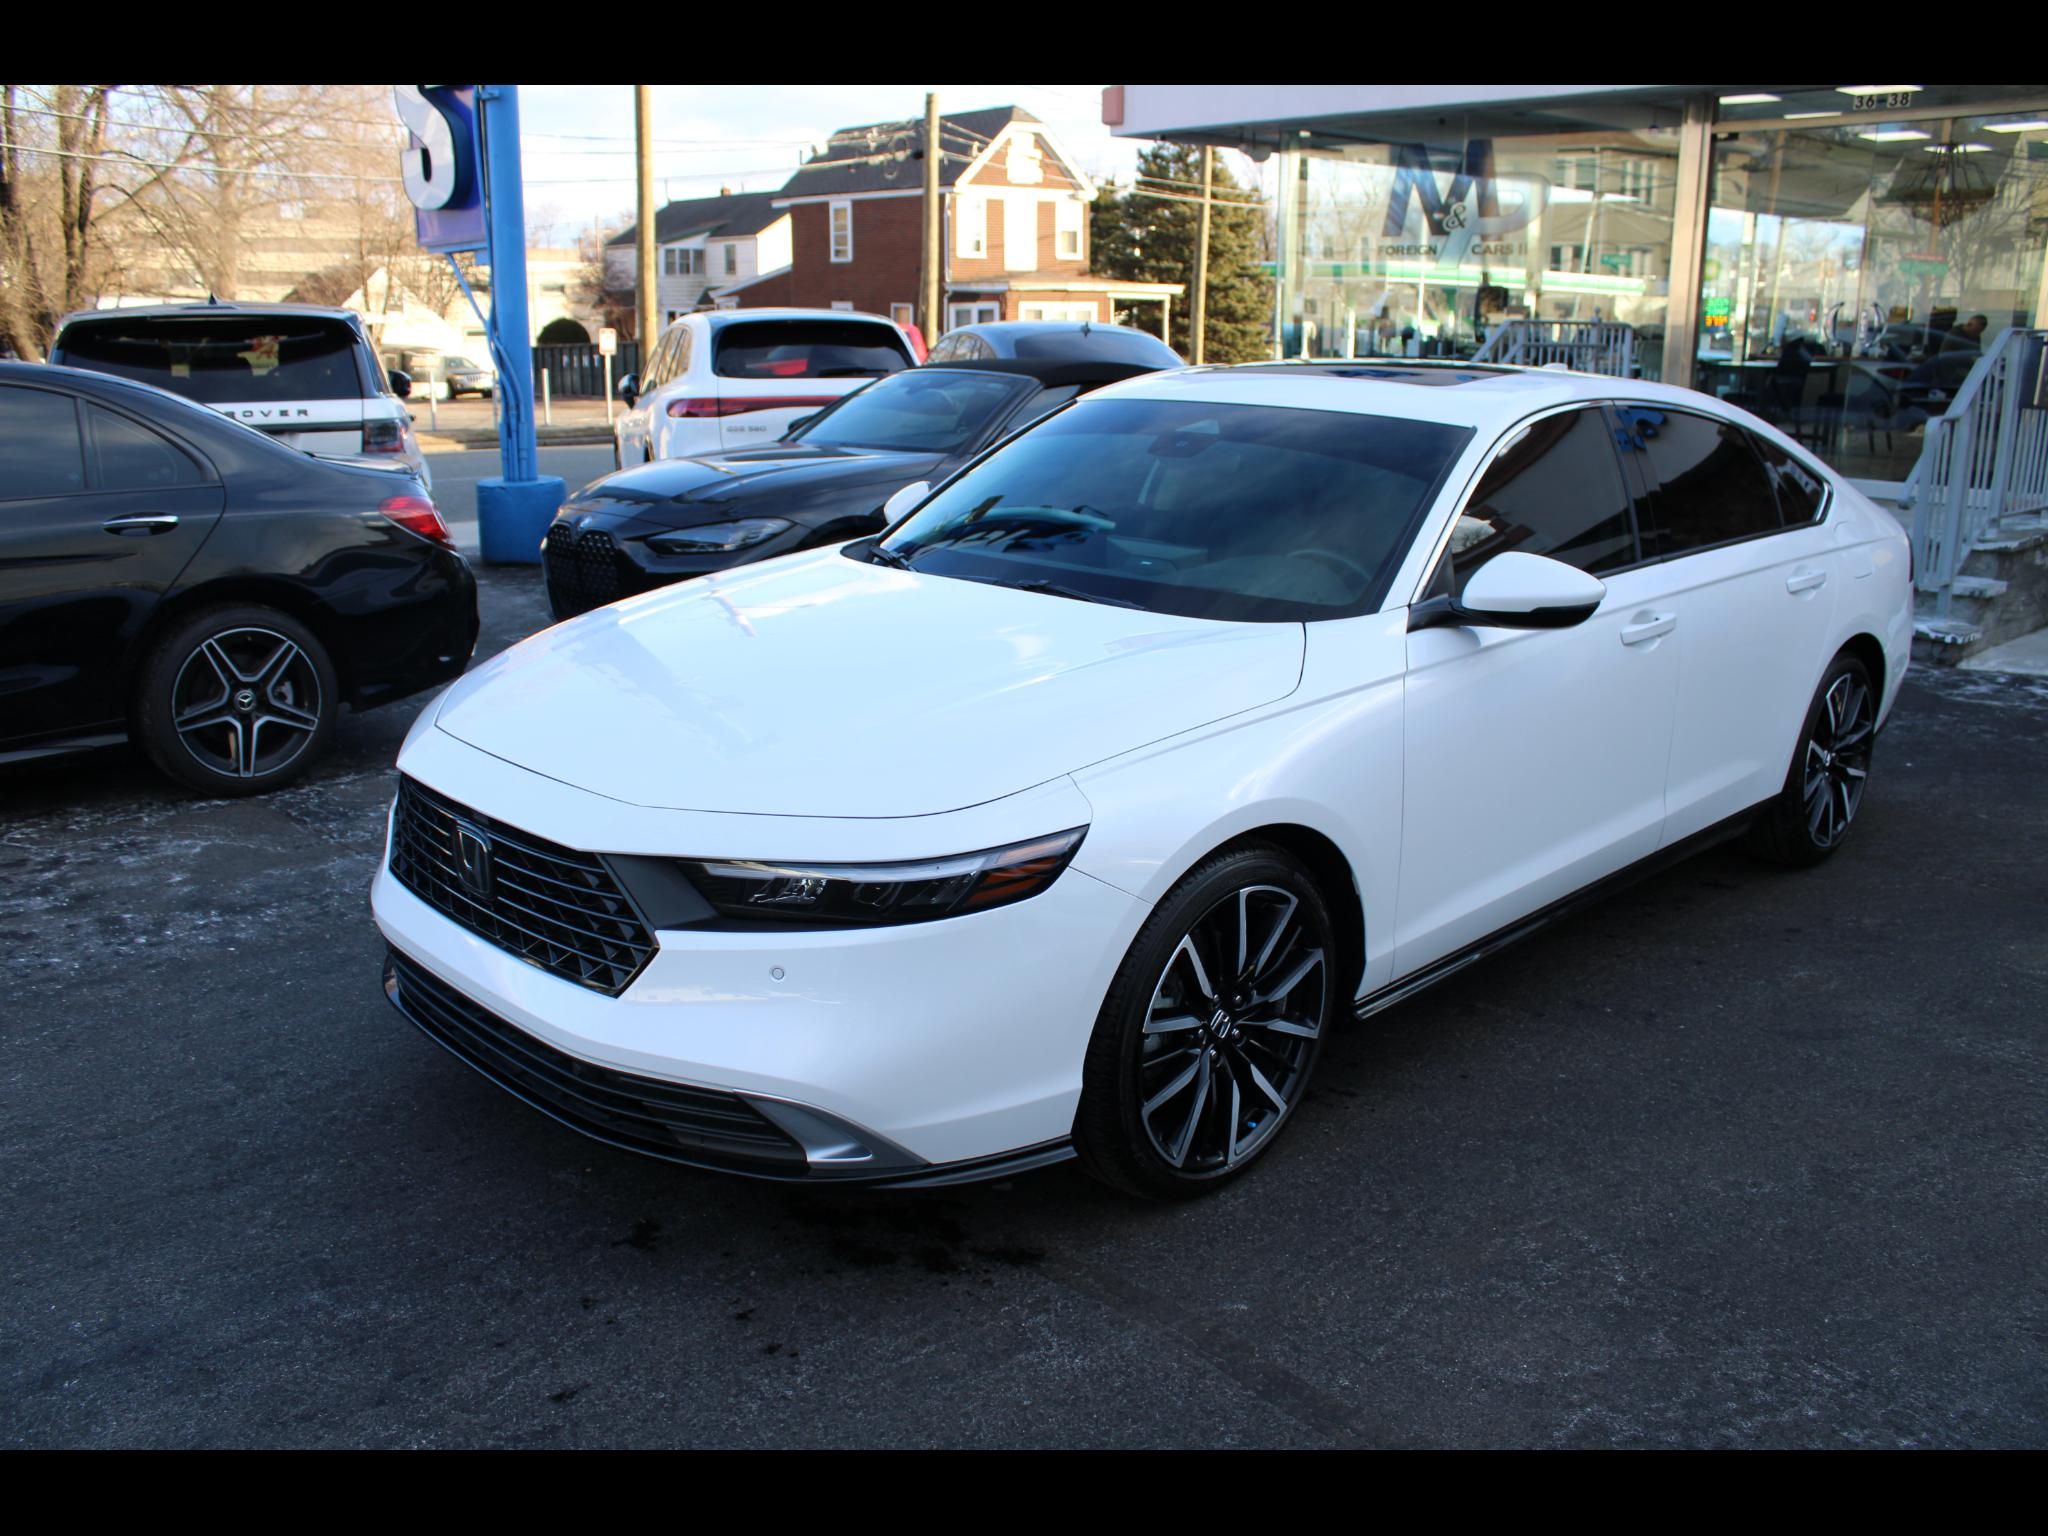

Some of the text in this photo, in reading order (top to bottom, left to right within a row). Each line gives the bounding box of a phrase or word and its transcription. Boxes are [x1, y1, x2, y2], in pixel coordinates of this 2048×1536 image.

[1854, 92, 1910, 109] 36-38
[1376, 244, 1438, 257] FOREIGN
[1471, 243, 1514, 256] CARS
[224, 408, 310, 419] ROVER
